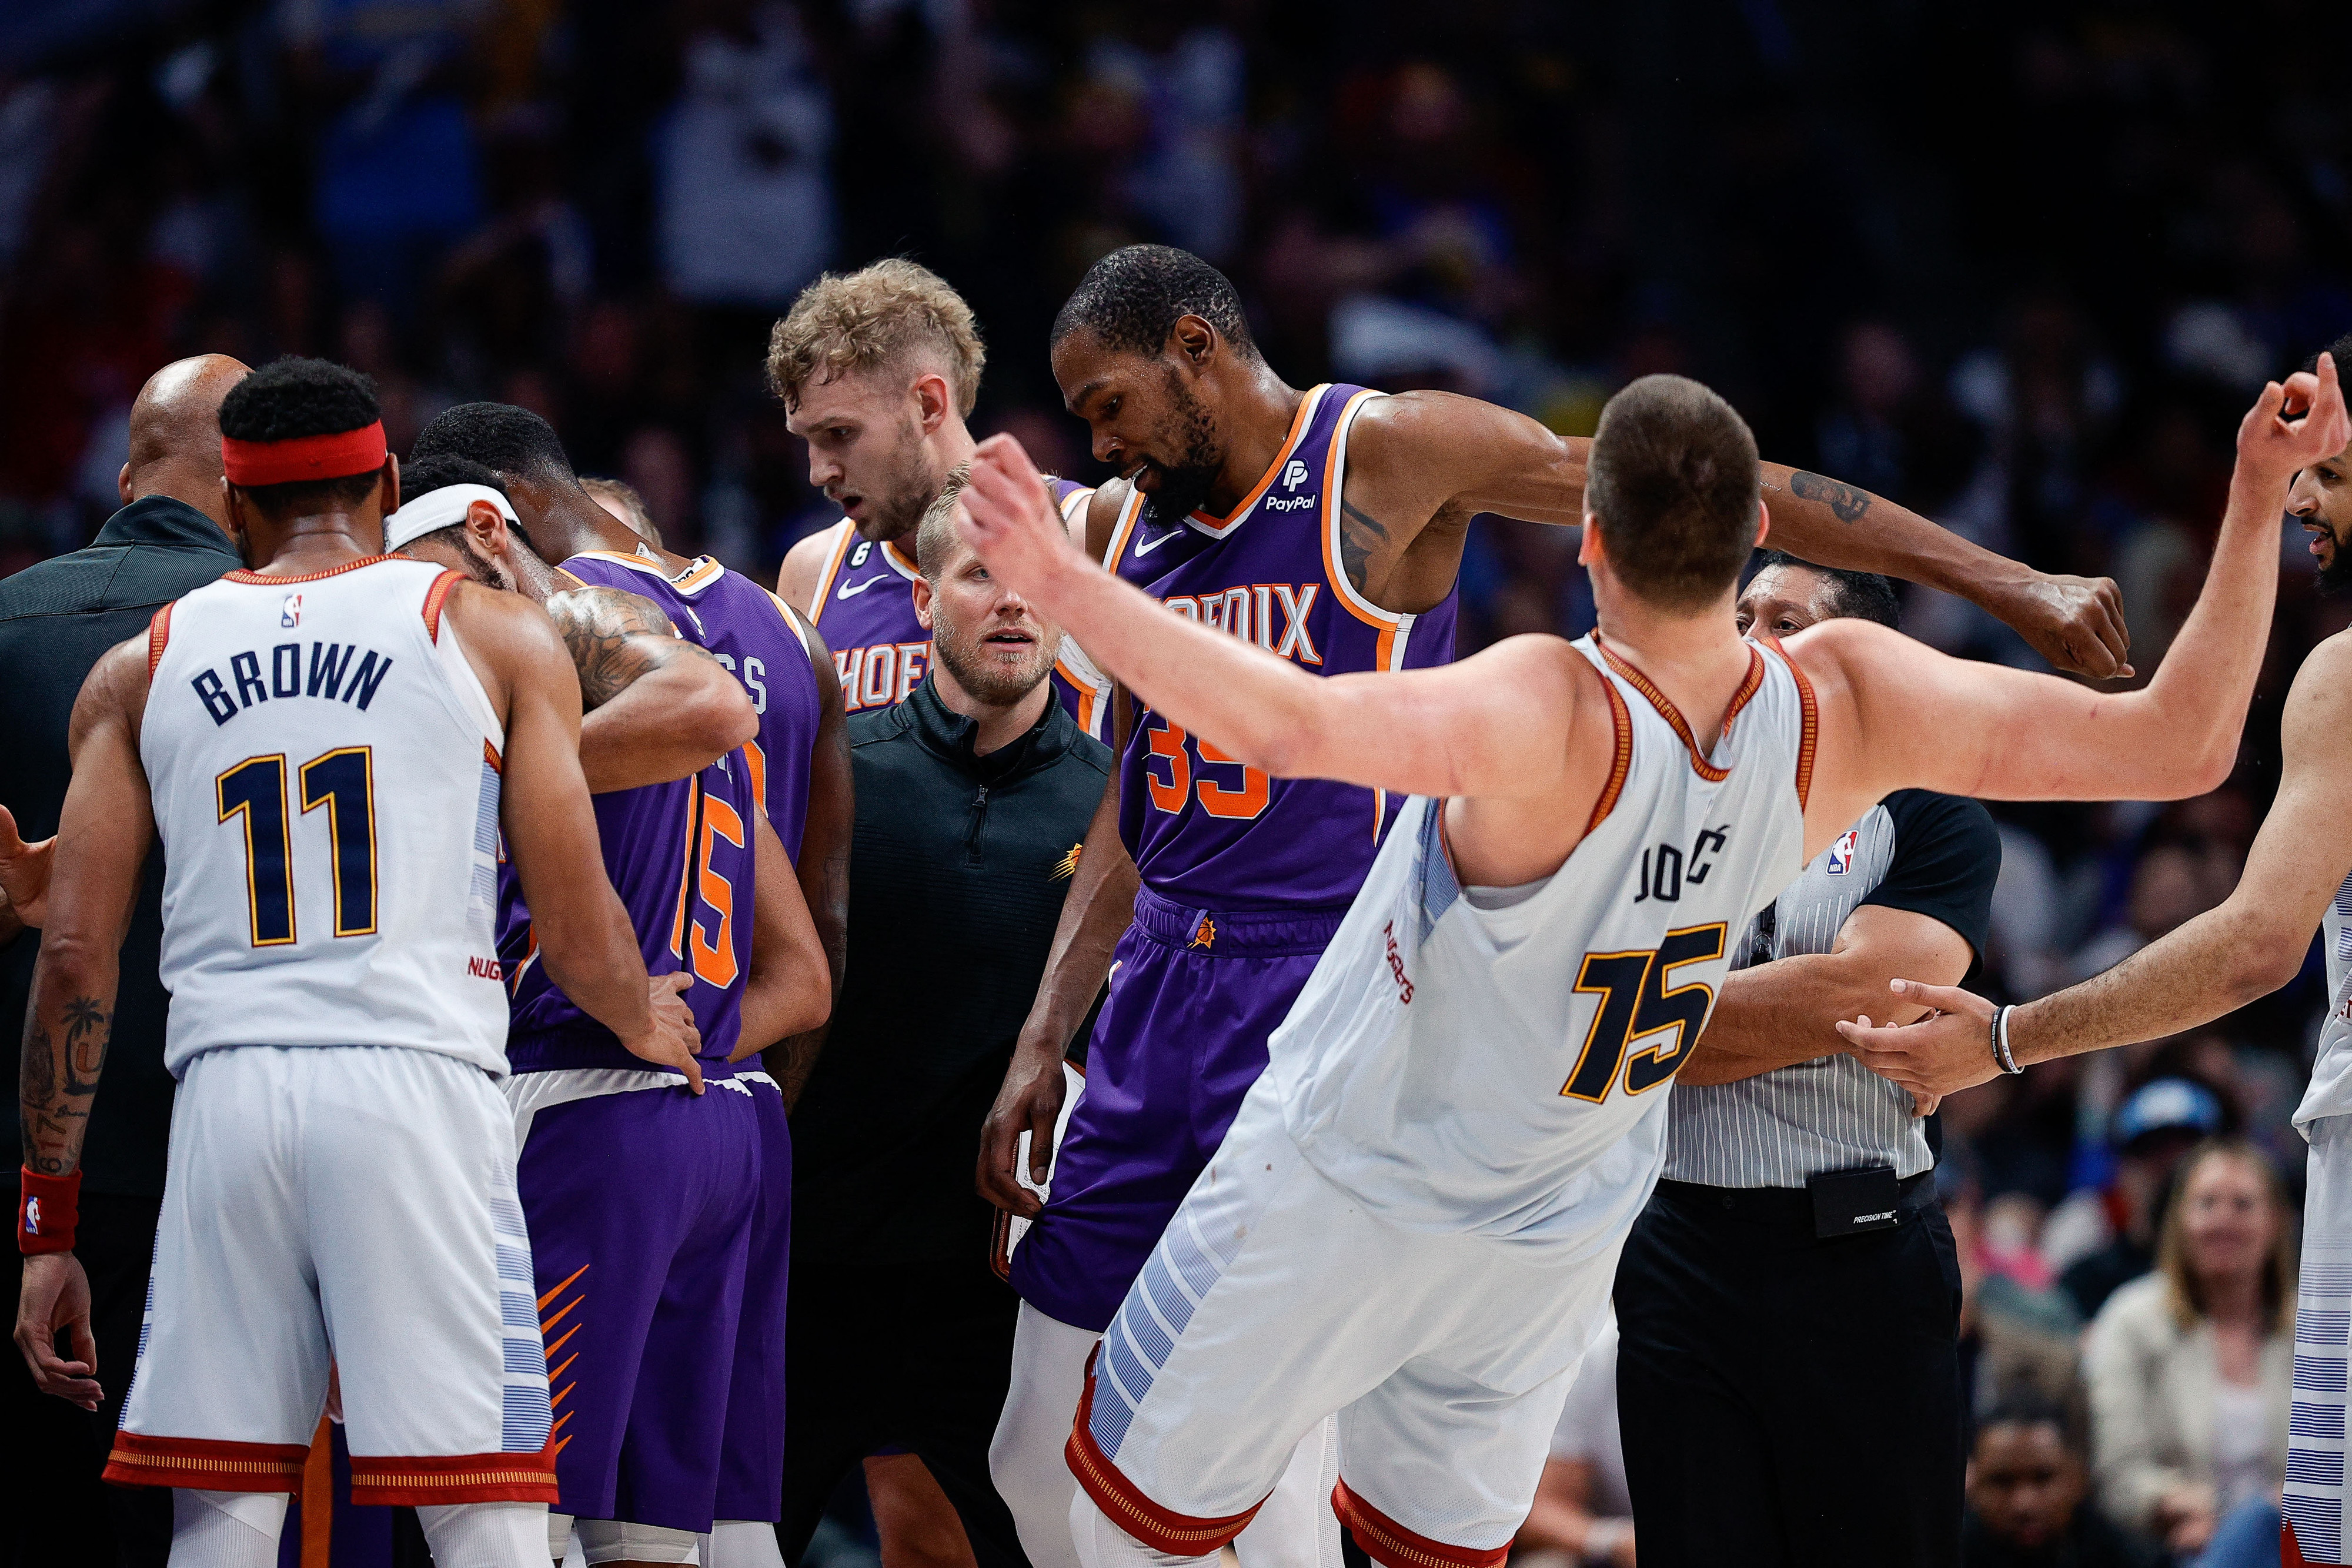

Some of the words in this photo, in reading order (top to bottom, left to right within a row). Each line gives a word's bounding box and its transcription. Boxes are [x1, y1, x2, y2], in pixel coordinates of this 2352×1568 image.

[1266, 494, 1315, 512] PayPal
[851, 541, 871, 566] 6
[191, 641, 393, 726] BROWN
[833, 640, 934, 712] HOE
[215, 745, 377, 948] 11
[1829, 864, 1842, 872] NBA
[467, 956, 504, 982] NUG
[1853, 1213, 1882, 1224] PRECISION
